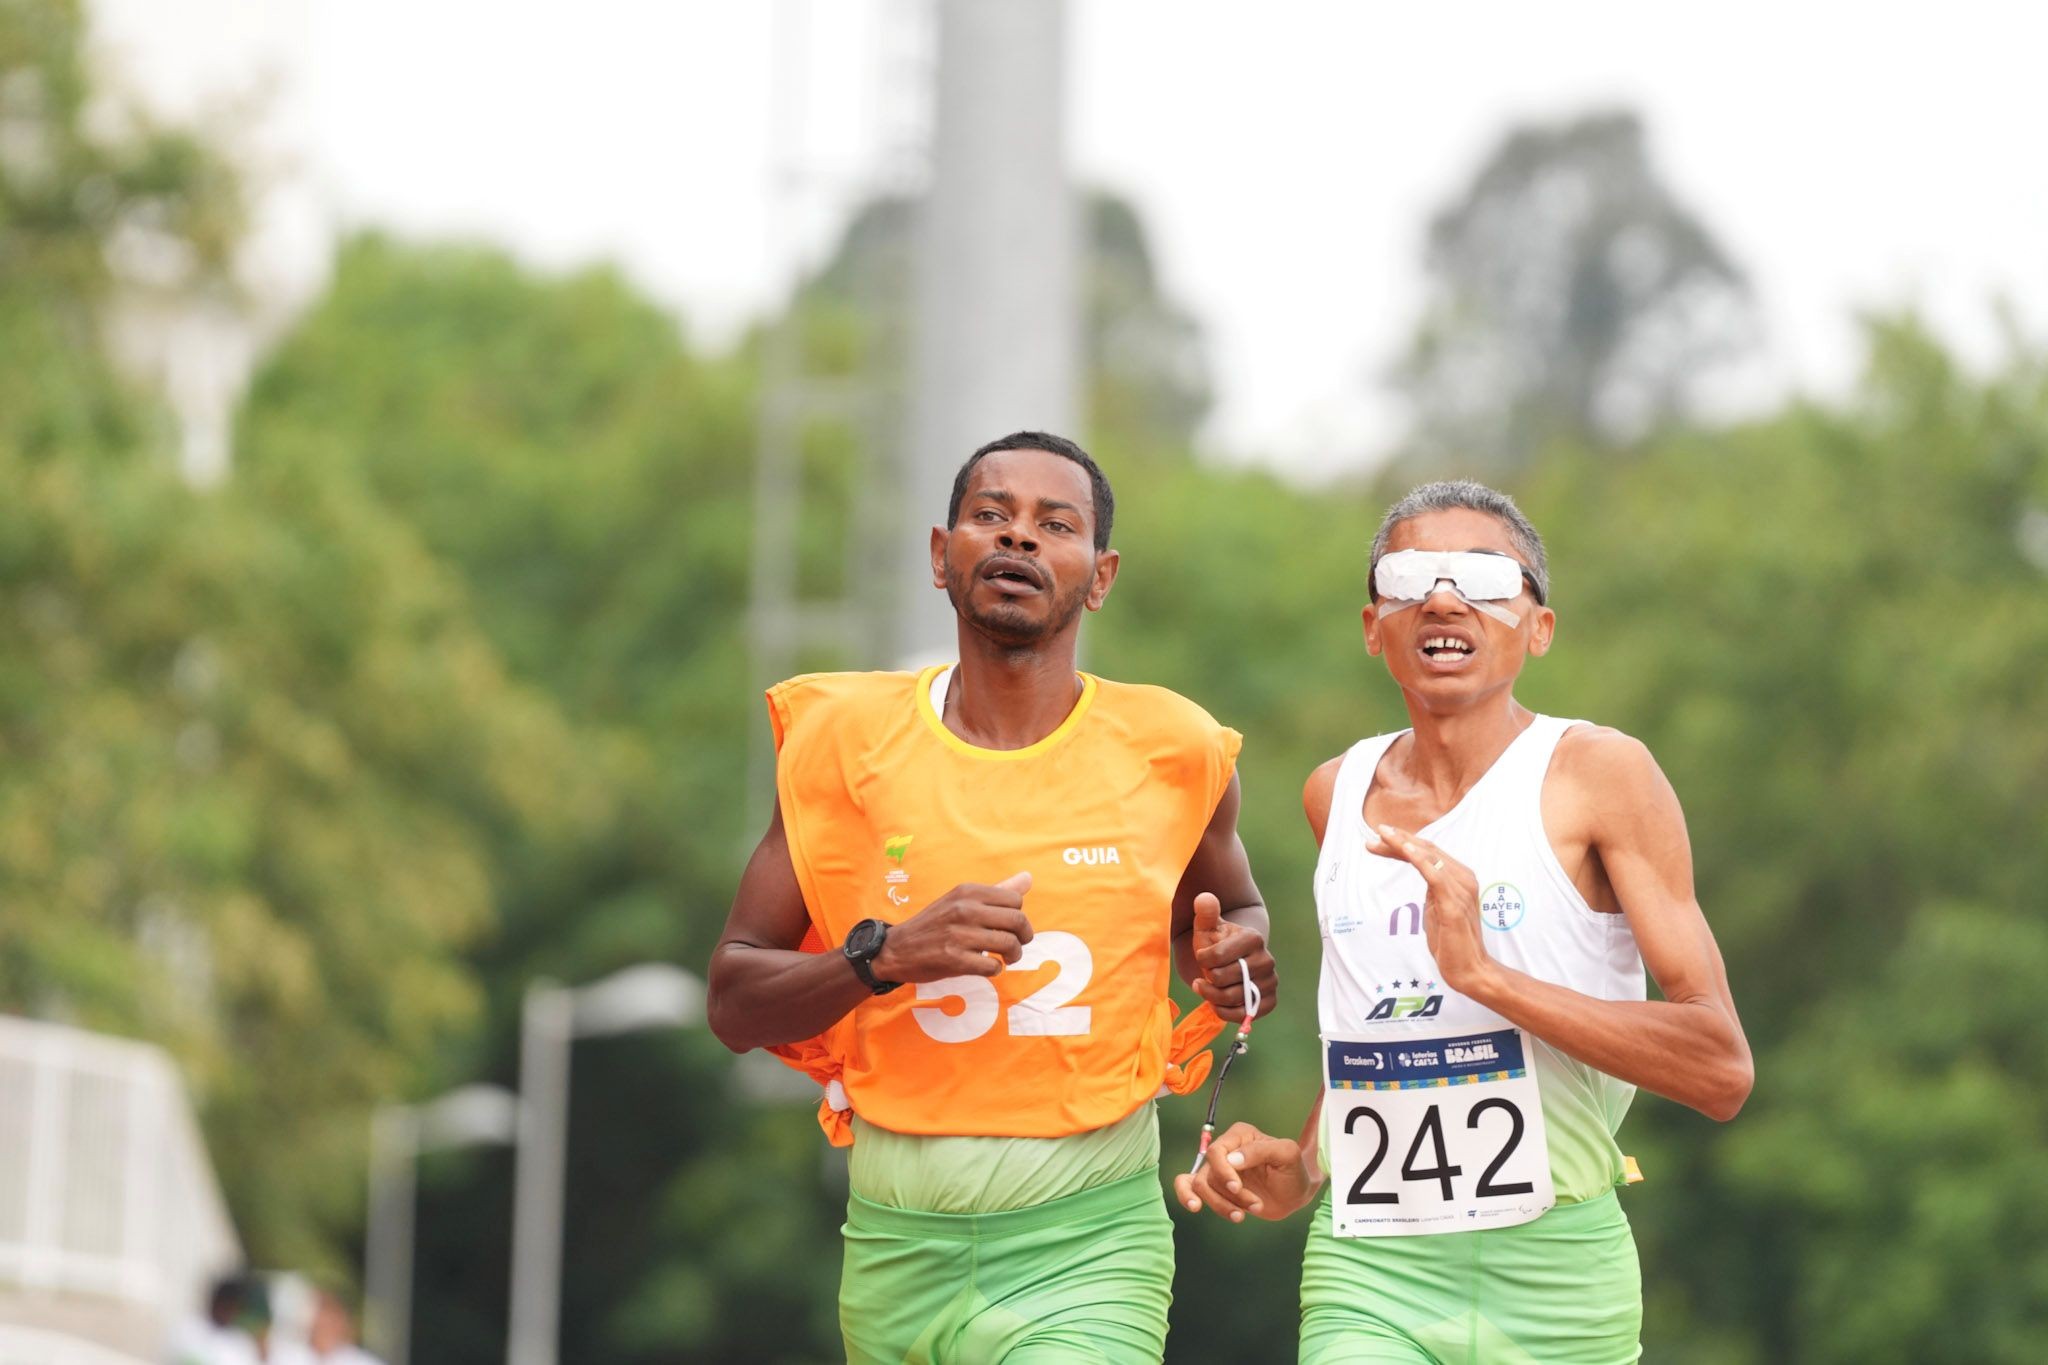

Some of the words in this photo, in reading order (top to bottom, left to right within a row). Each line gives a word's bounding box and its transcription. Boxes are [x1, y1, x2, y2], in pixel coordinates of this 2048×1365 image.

[1063, 847, 1120, 865] GUIA
[1482, 902, 1521, 911] BAYER
[1498, 886, 1506, 927] BAYER
[1343, 1055, 1375, 1067] Braskem
[1413, 1058, 1439, 1067] CAIXA
[1444, 1043, 1499, 1065] BRASIL
[1344, 1097, 1534, 1205] 242
